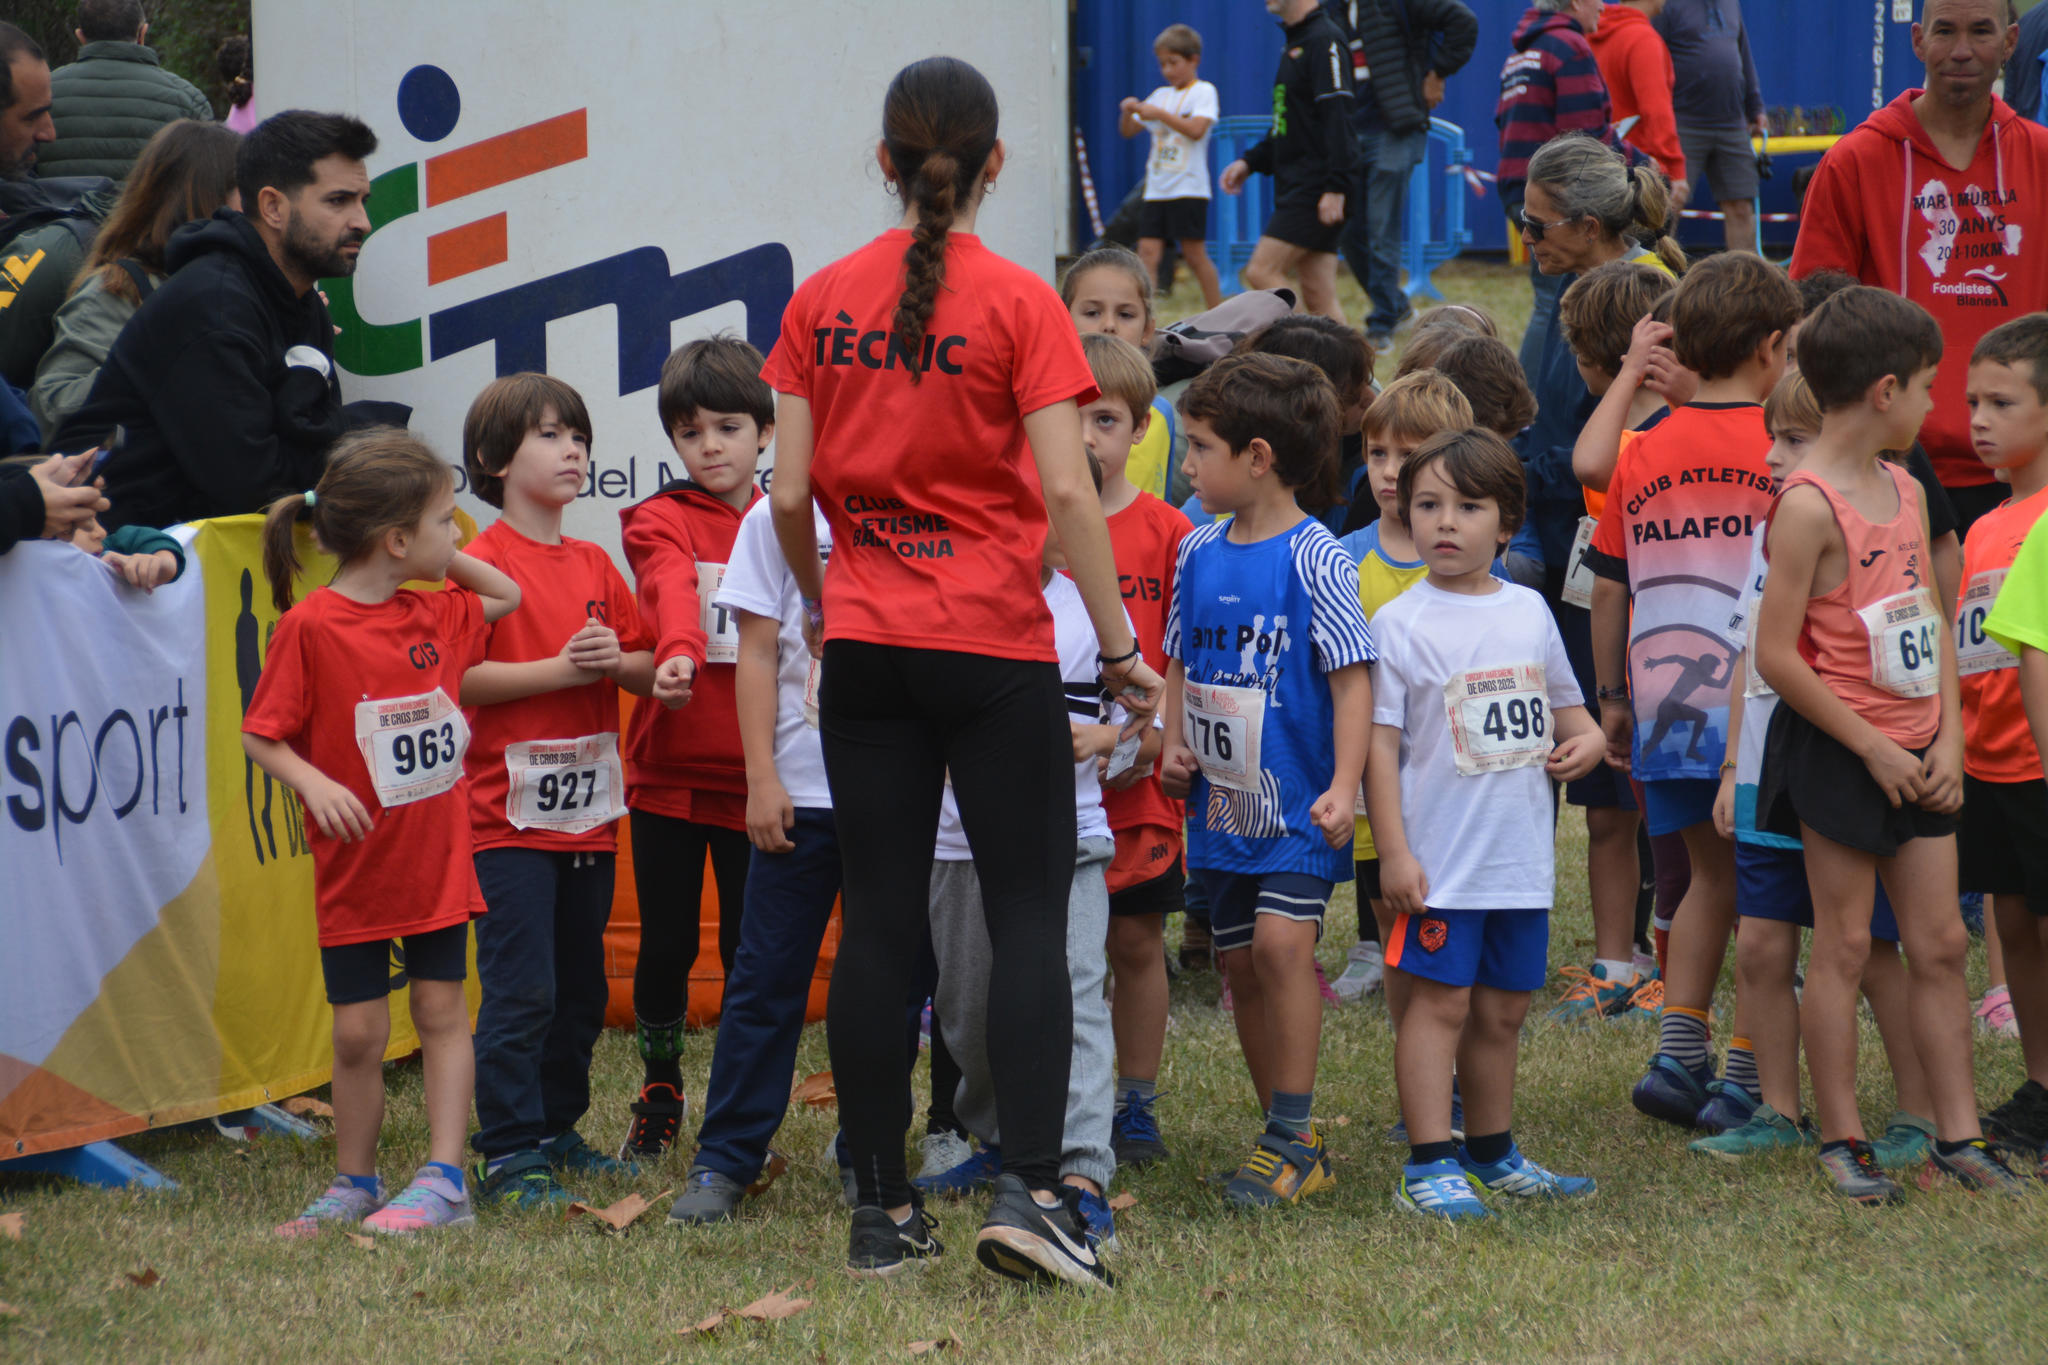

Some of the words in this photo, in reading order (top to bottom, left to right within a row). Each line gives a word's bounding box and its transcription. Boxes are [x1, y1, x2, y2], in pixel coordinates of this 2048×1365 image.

[1913, 193, 1947, 210] MAR
[1939, 219, 1956, 235] 30
[1960, 215, 2006, 234] ANYS
[1937, 246, 1952, 260] 20
[1932, 282, 1993, 295] Fondistes
[1956, 295, 1999, 306] Blanes
[814, 310, 967, 376] TÈCNIC
[844, 495, 906, 514] CLUB
[1627, 474, 1672, 515] CLUB
[1633, 514, 1754, 545] PALAFOL
[1191, 625, 1228, 651] ant
[1236, 624, 1283, 656] Pol
[1467, 683, 1477, 695] DE
[1477, 680, 1497, 694] CROS
[1497, 677, 1516, 690] 2025
[380, 714, 390, 727] DE
[391, 711, 411, 725] CROS
[412, 708, 429, 722] 2025
[1483, 697, 1545, 742] 498
[1188, 711, 1232, 761] 776
[392, 722, 456, 776] 963
[540, 753, 558, 765] CROS
[0, 677, 188, 866] sport
[537, 769, 596, 812] 927
